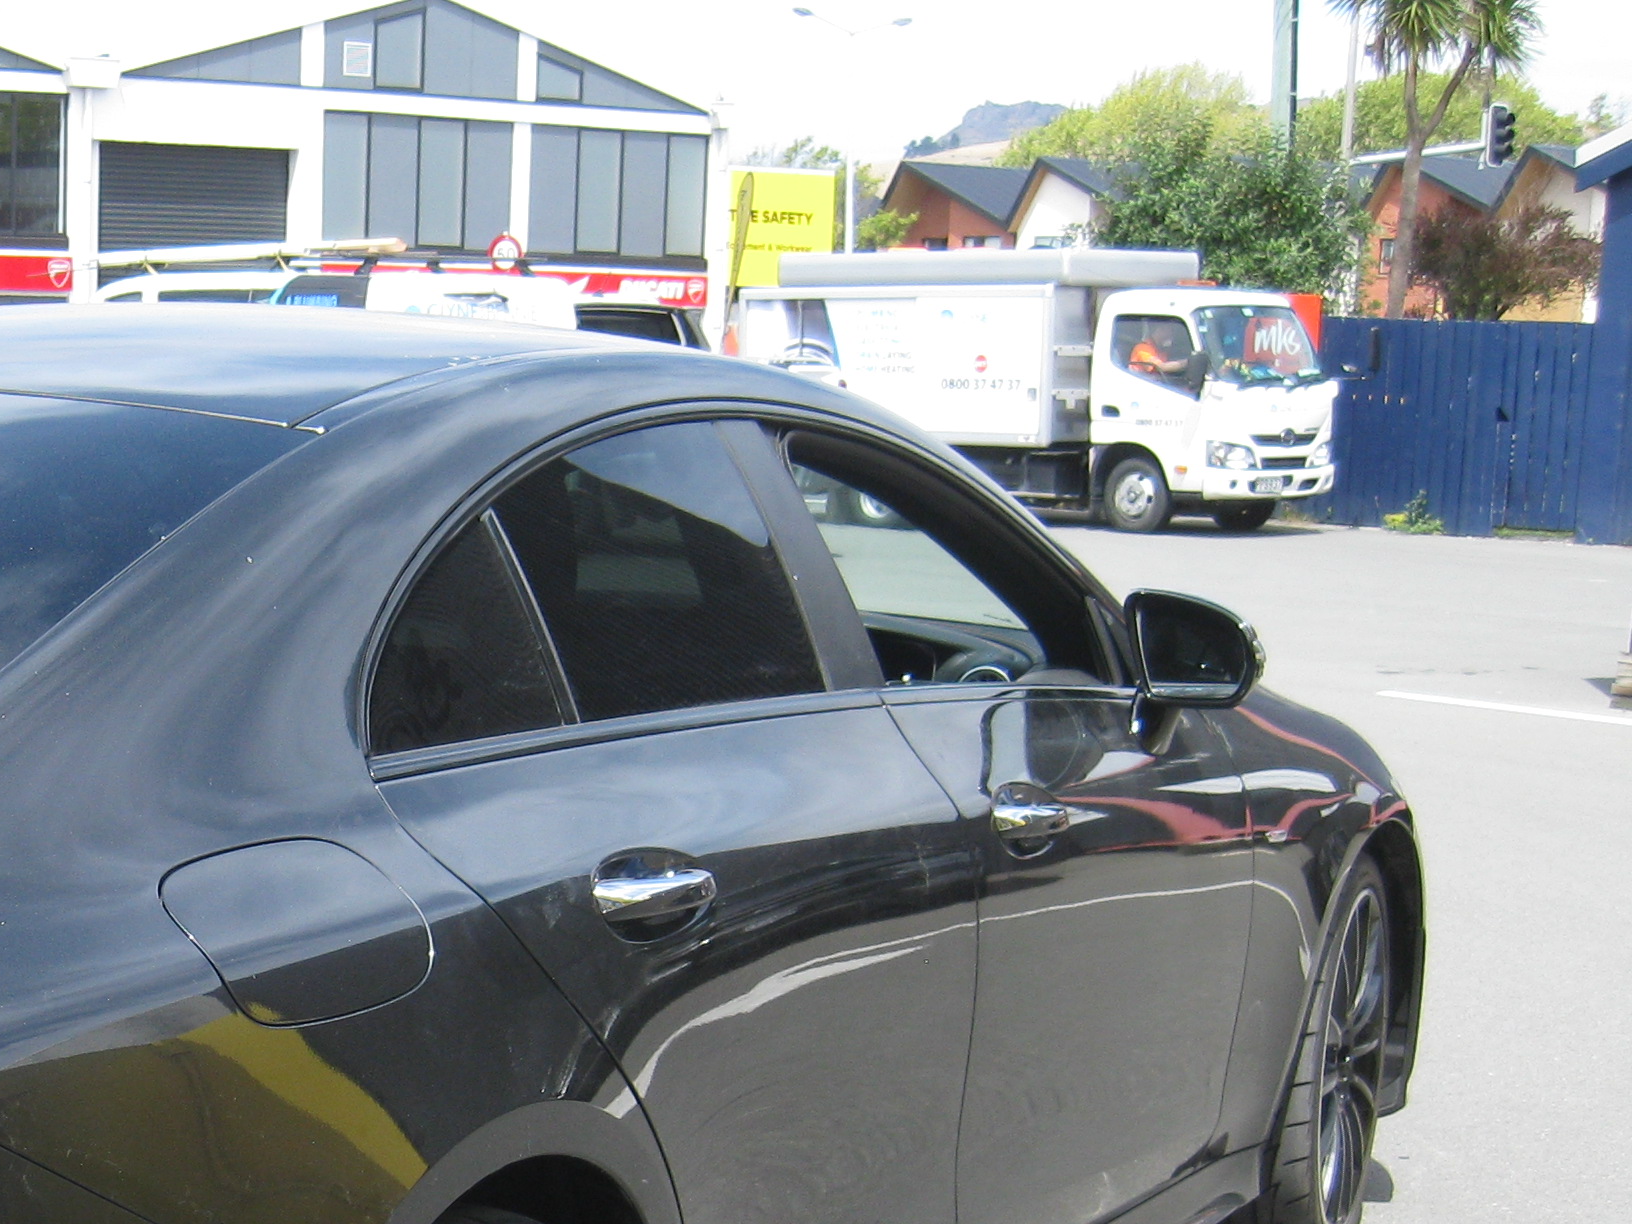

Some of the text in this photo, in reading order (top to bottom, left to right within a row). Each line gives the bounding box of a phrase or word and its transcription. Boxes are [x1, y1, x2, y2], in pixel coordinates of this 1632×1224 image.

[728, 209, 814, 225] TE SAFETY
[497, 246, 516, 259] 50
[941, 378, 1021, 391] 0800 37 47 37
